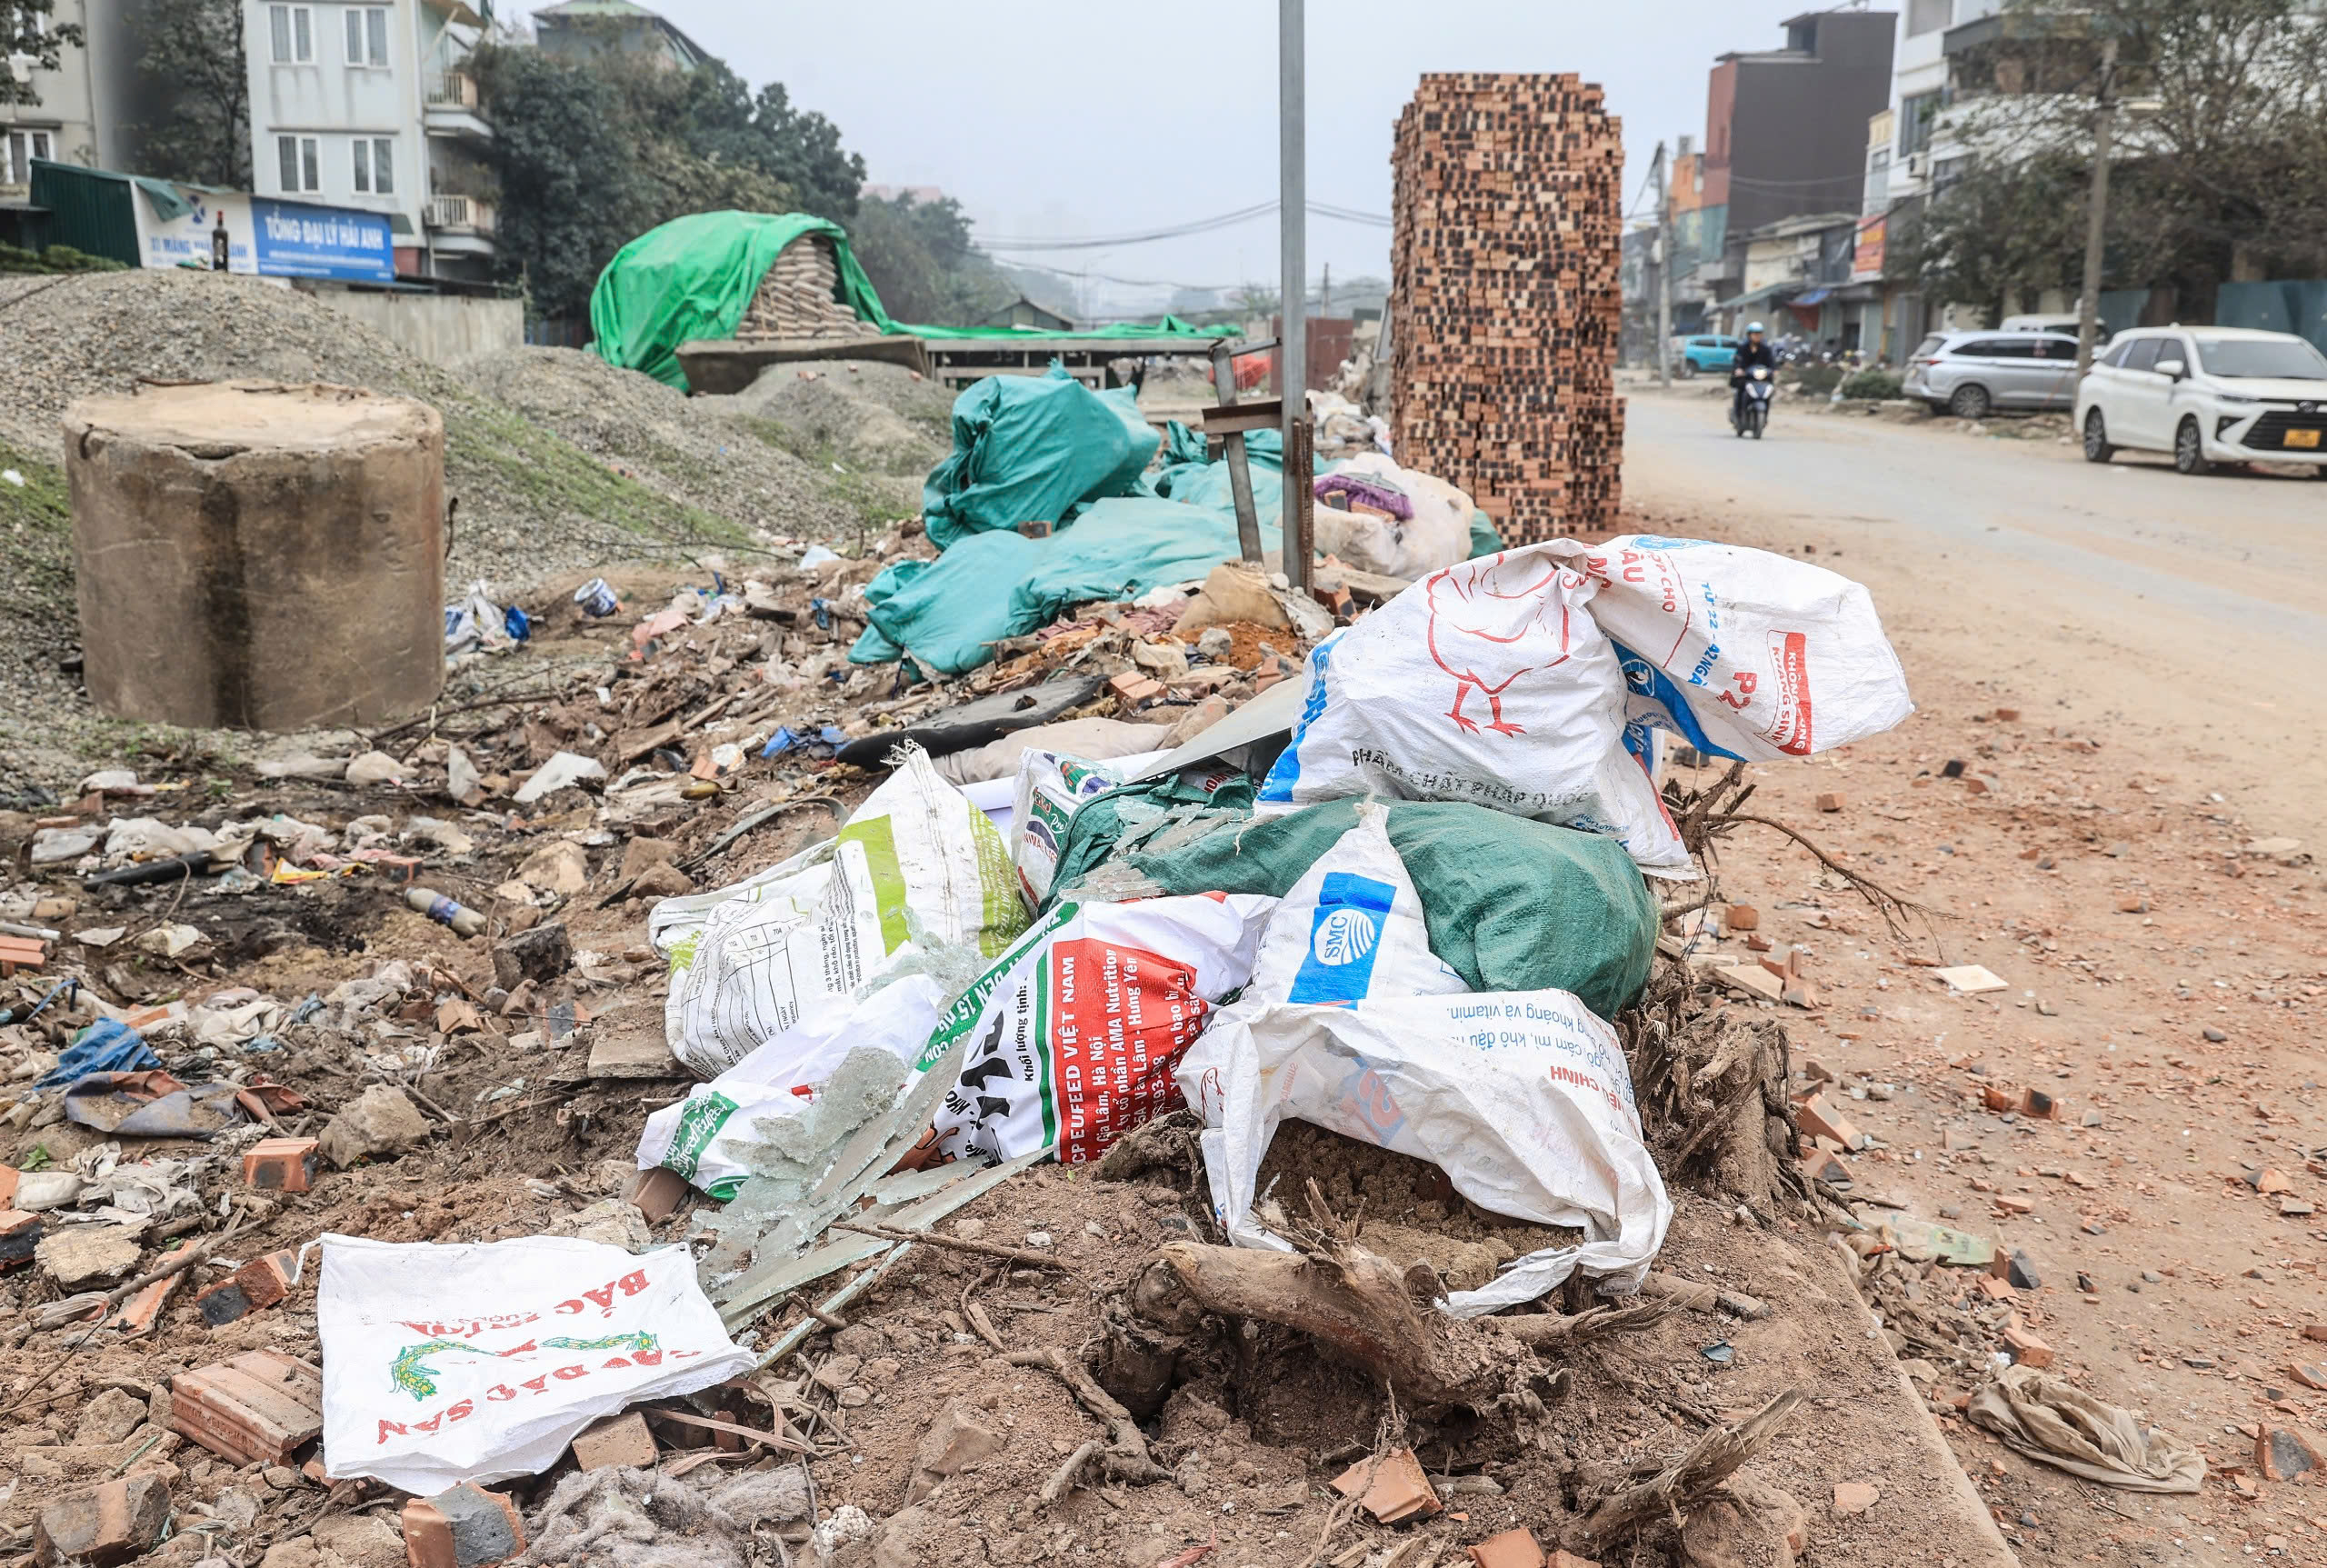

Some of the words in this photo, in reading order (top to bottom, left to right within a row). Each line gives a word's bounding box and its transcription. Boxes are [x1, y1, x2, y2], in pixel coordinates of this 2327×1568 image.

[1660, 577, 1676, 613] CHO
[1707, 610, 1719, 630] 22
[1324, 915, 1348, 960] SMC
[1062, 956, 1076, 1003] NAM
[1104, 948, 1121, 1014] Nutrition
[954, 994, 980, 1022] 15
[1017, 984, 1030, 1014] tịnh:
[1126, 985, 1143, 1026] Hưng
[1445, 1004, 1502, 1024] vitamin.
[1504, 1004, 1522, 1023] và
[1170, 1004, 1184, 1033] bao
[1525, 1003, 1573, 1033] khoáng
[1015, 1016, 1028, 1053] lượng
[1057, 1011, 1081, 1059] VIỆT
[1088, 1035, 1106, 1061] Nội
[1108, 1016, 1124, 1054] AMA
[1468, 1028, 1496, 1052] đậu
[1499, 1031, 1527, 1048] khô
[1555, 1039, 1583, 1058] cám
[1019, 1054, 1034, 1082] Khối
[1133, 1038, 1147, 1074] Lâm
[1093, 1066, 1107, 1086] Hà
[1110, 1054, 1129, 1096] phần
[1549, 1065, 1600, 1093] CHÍNH
[1065, 1064, 1086, 1140] EUFEED
[1095, 1090, 1111, 1123] Lâm,
[554, 1268, 652, 1319] BẮC
